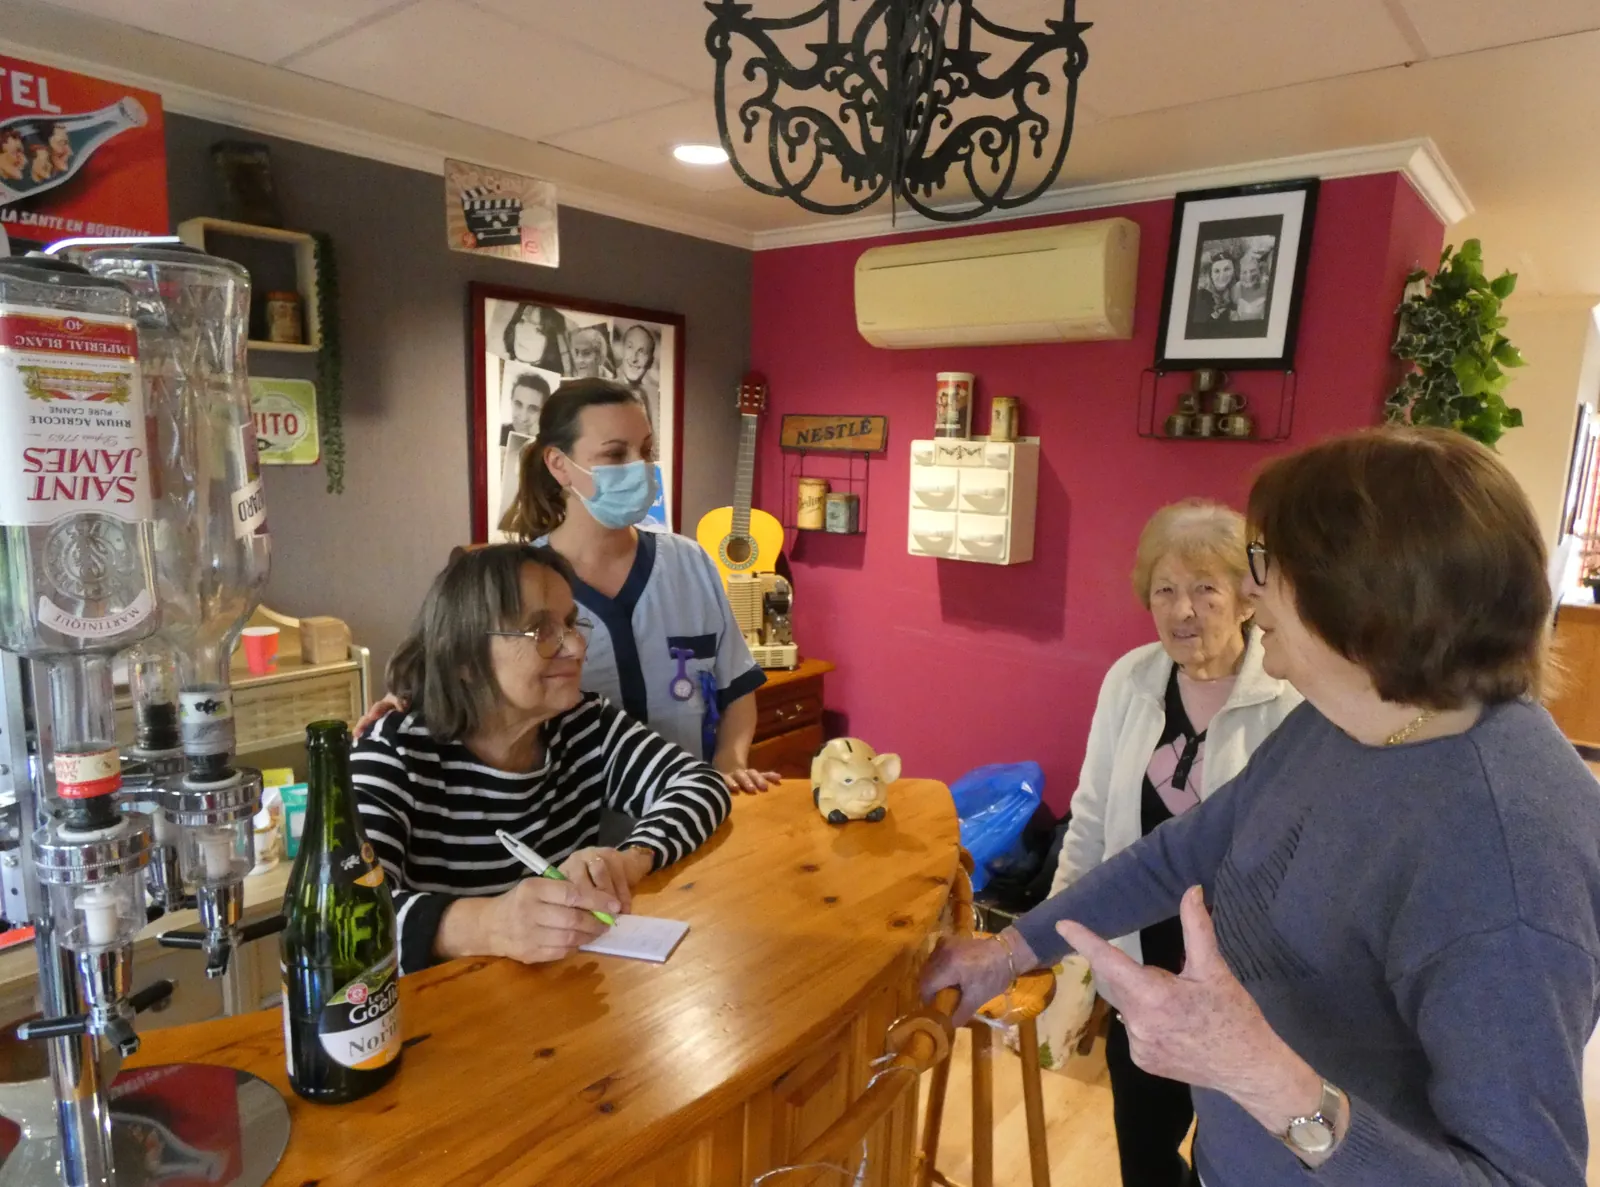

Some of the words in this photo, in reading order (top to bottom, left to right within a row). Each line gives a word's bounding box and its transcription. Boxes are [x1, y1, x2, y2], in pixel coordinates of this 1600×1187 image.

[1, 208, 17, 223] LA
[65, 219, 83, 232] EN
[65, 320, 83, 331] 40
[15, 335, 63, 350] BLANC
[67, 340, 131, 354] IMPERIAL
[50, 406, 85, 416] CANNE
[88, 408, 113, 416] PURE
[30, 415, 92, 426] AGRICOLE
[96, 418, 132, 429] RHUM
[253, 412, 298, 436] ITO
[23, 447, 142, 474] JAMES
[27, 475, 137, 503] SAINT
[53, 607, 140, 631] MARTINIQUE
